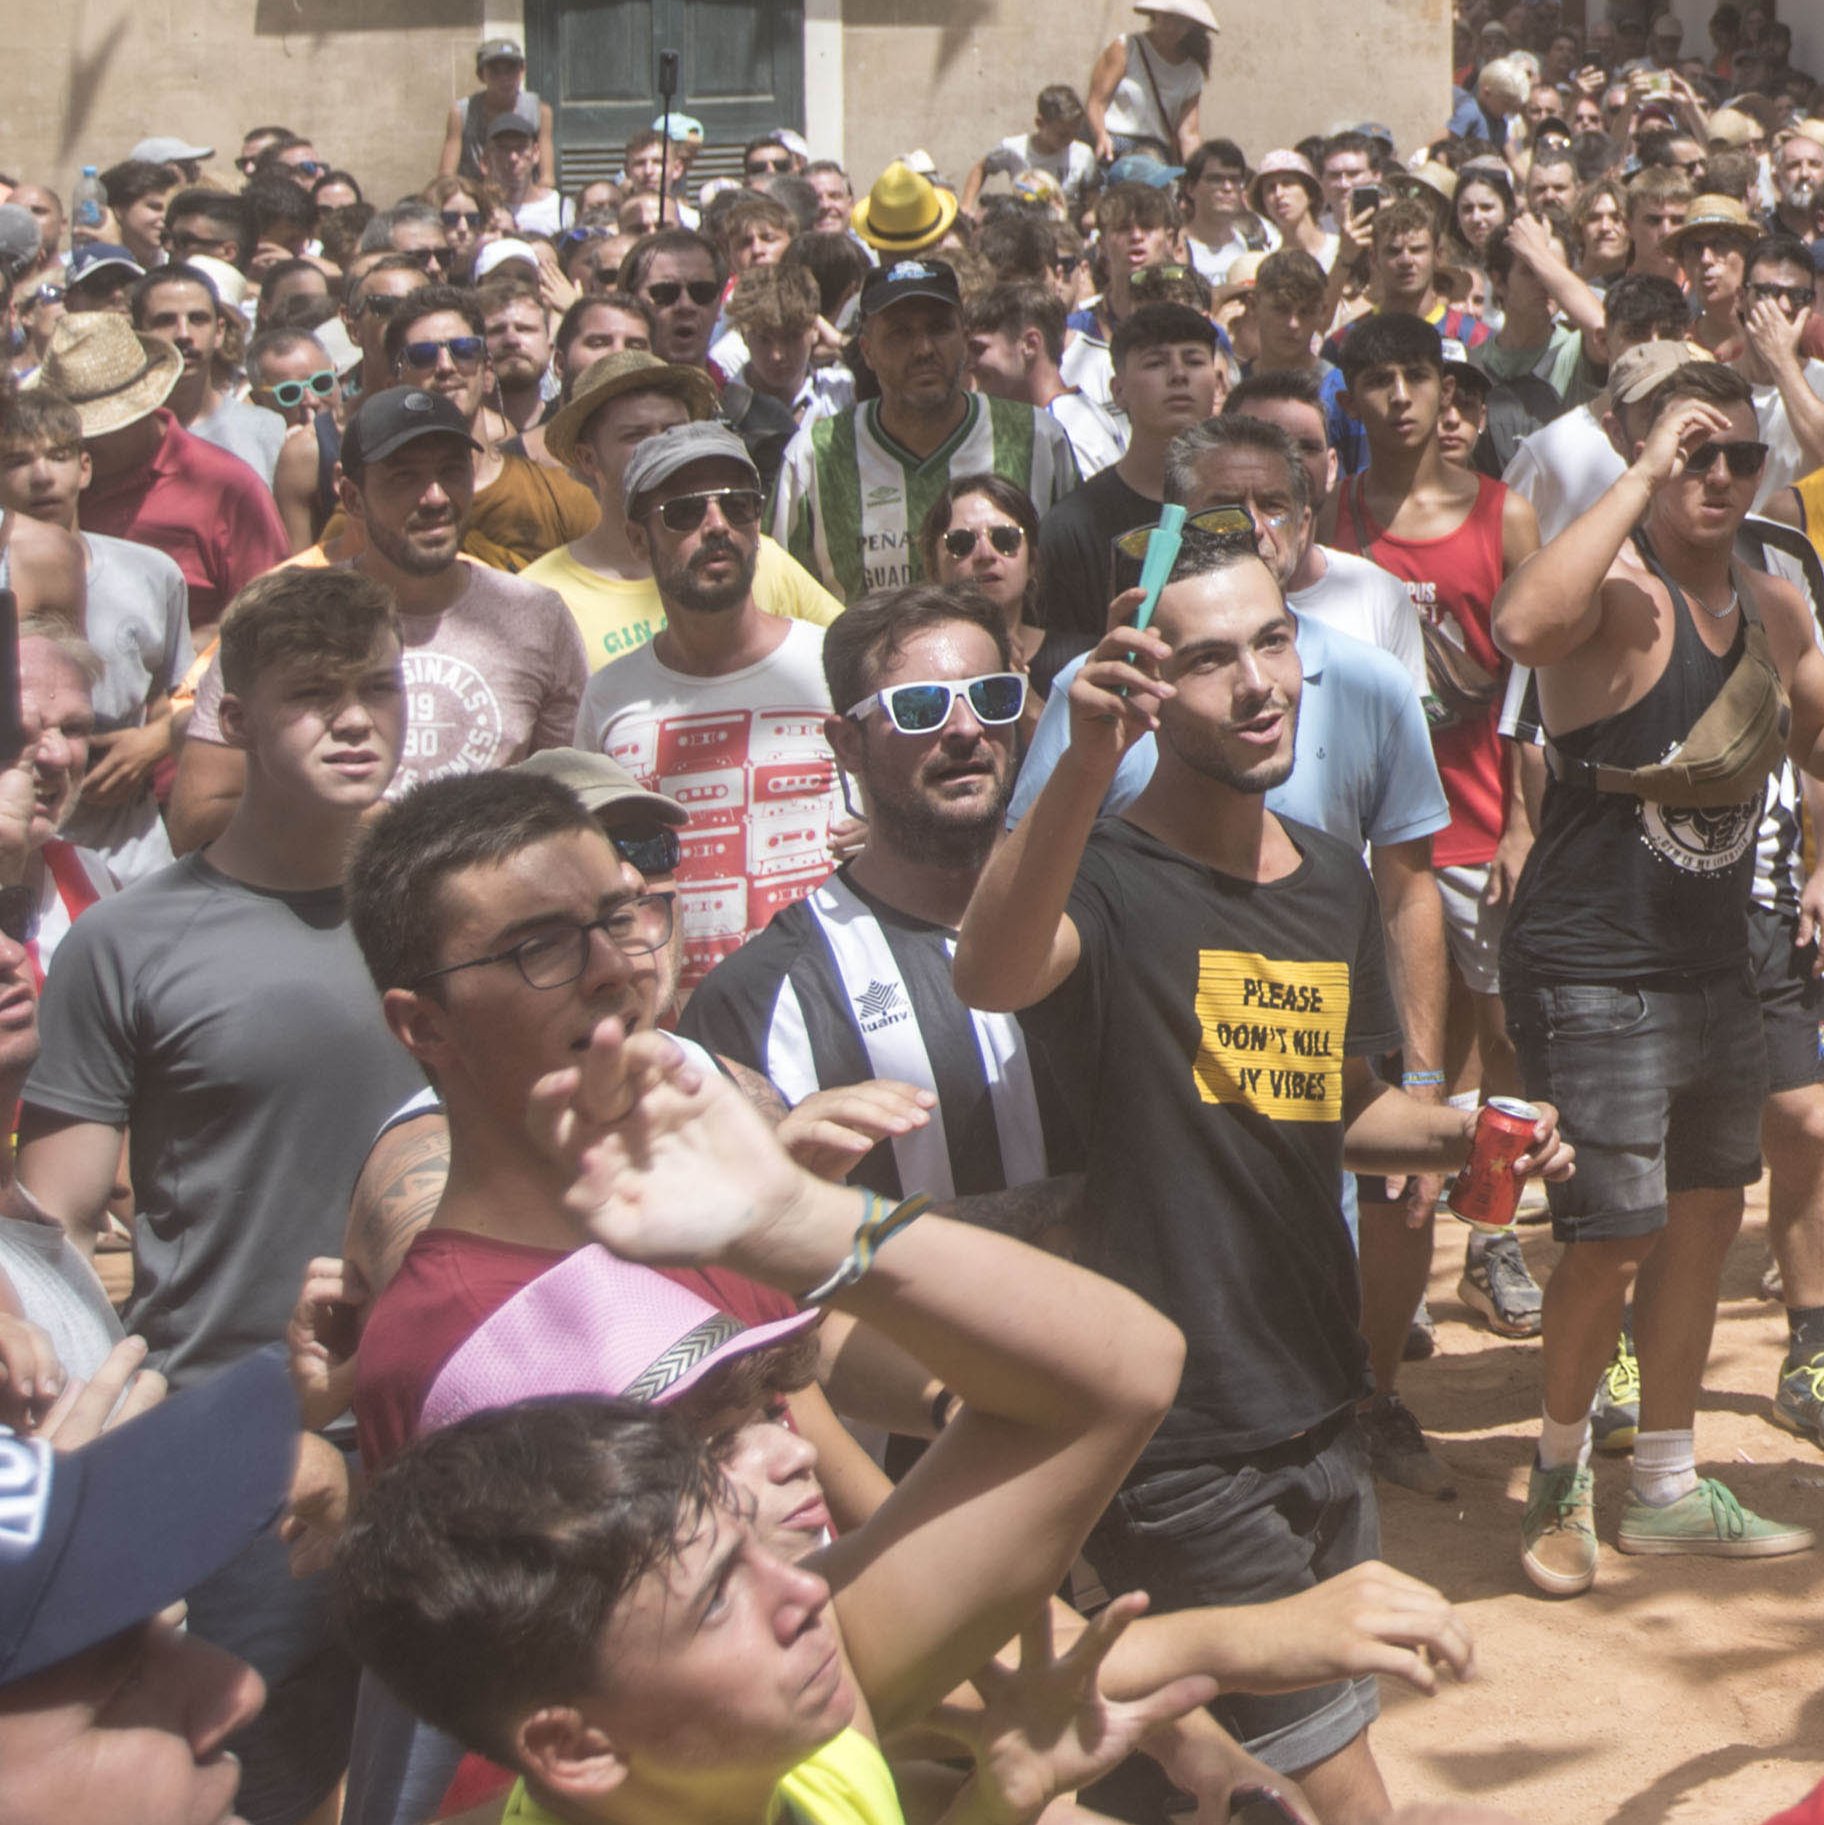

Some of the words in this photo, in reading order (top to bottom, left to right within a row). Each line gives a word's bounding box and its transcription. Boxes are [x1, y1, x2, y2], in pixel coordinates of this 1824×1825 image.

[603, 620, 653, 653] GIN
[1243, 978, 1323, 1013] PLEASE
[1217, 1023, 1286, 1053] DON'T
[1292, 1029, 1332, 1056] KILL
[1270, 1069, 1327, 1102] VIBES
